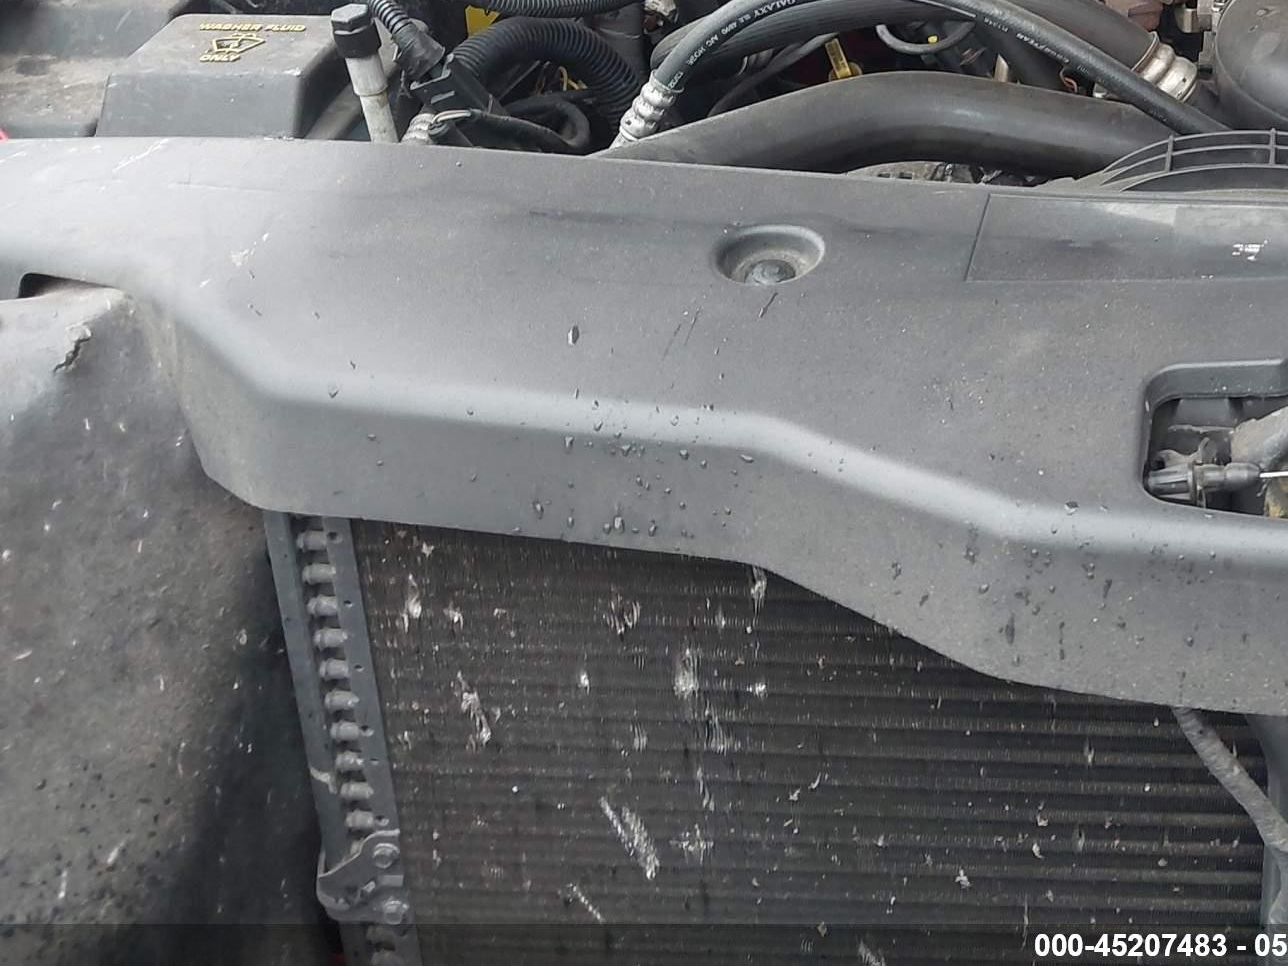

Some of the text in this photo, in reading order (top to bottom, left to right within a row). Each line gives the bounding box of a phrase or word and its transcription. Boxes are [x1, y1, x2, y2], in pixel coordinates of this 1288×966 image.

[199, 23, 306, 32] WASHER FLUID
[199, 54, 241, 62] ONLY
